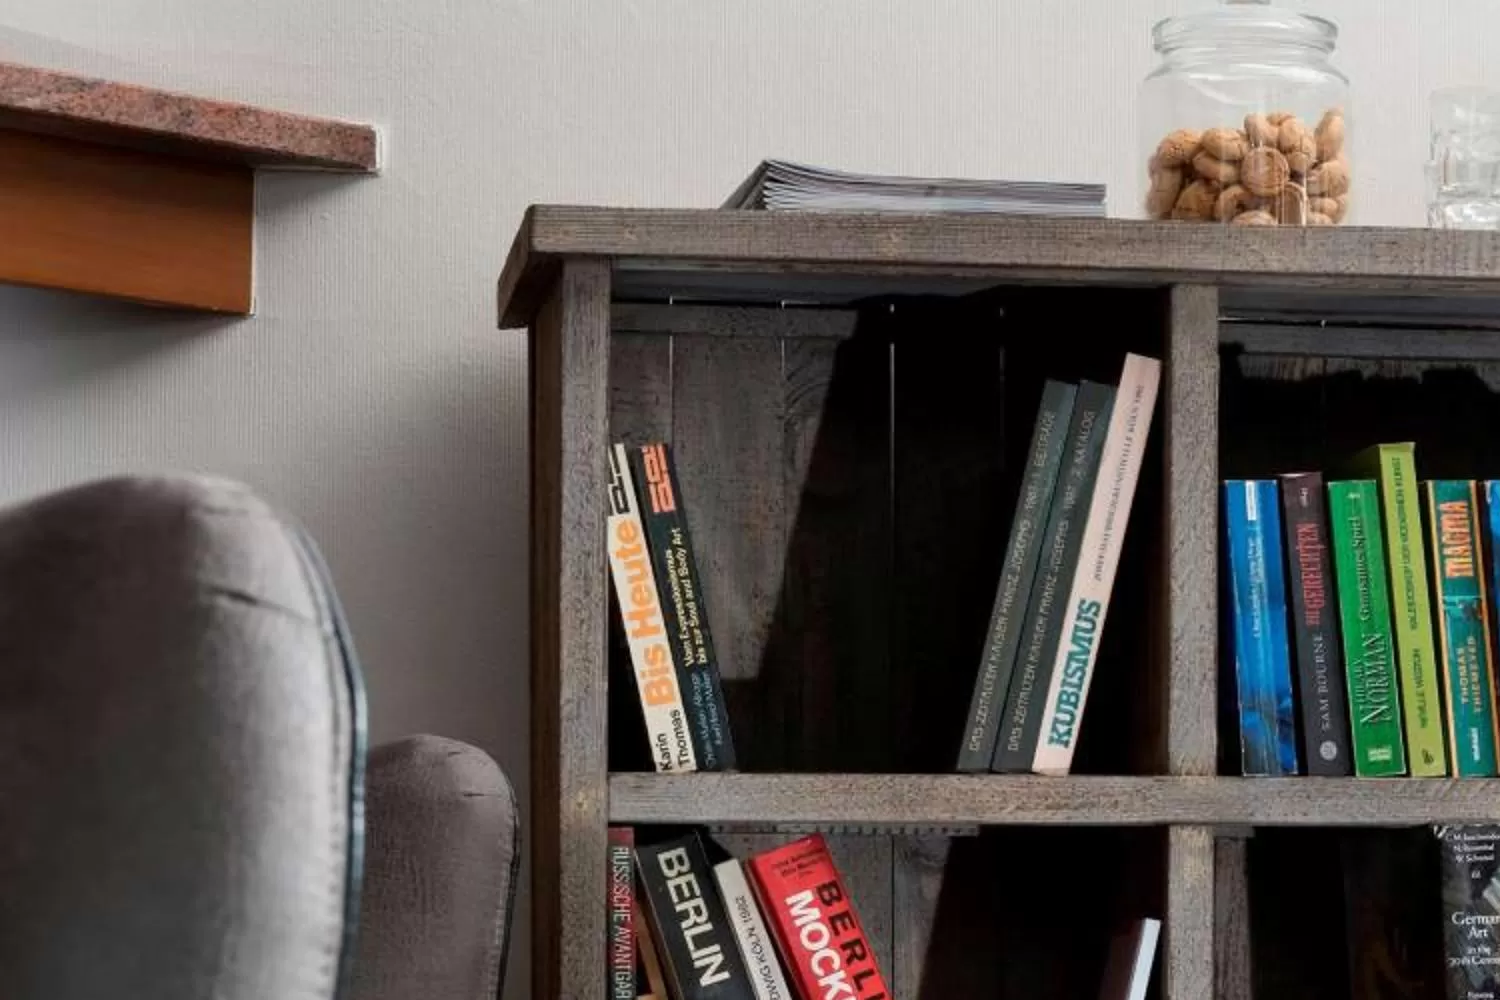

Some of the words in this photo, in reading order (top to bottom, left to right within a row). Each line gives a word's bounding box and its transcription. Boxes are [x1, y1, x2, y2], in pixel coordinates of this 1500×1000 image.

[669, 527, 683, 546] Art
[1295, 523, 1324, 609] GERECHTEN
[614, 518, 663, 640] Heute
[643, 643, 676, 706] Bis
[1048, 599, 1100, 748] KUBISMUS
[1310, 632, 1330, 693] BOURNE
[1350, 631, 1392, 725] NORMAN
[1457, 648, 1468, 702] THOMAS
[671, 710, 689, 766] Thomas
[1317, 696, 1332, 730] SAM
[657, 734, 673, 772] Karin
[613, 847, 630, 920] RUSSISCHE
[658, 848, 730, 986] BERLIN
[748, 927, 765, 963] KÖLN
[1468, 926, 1488, 939] Art
